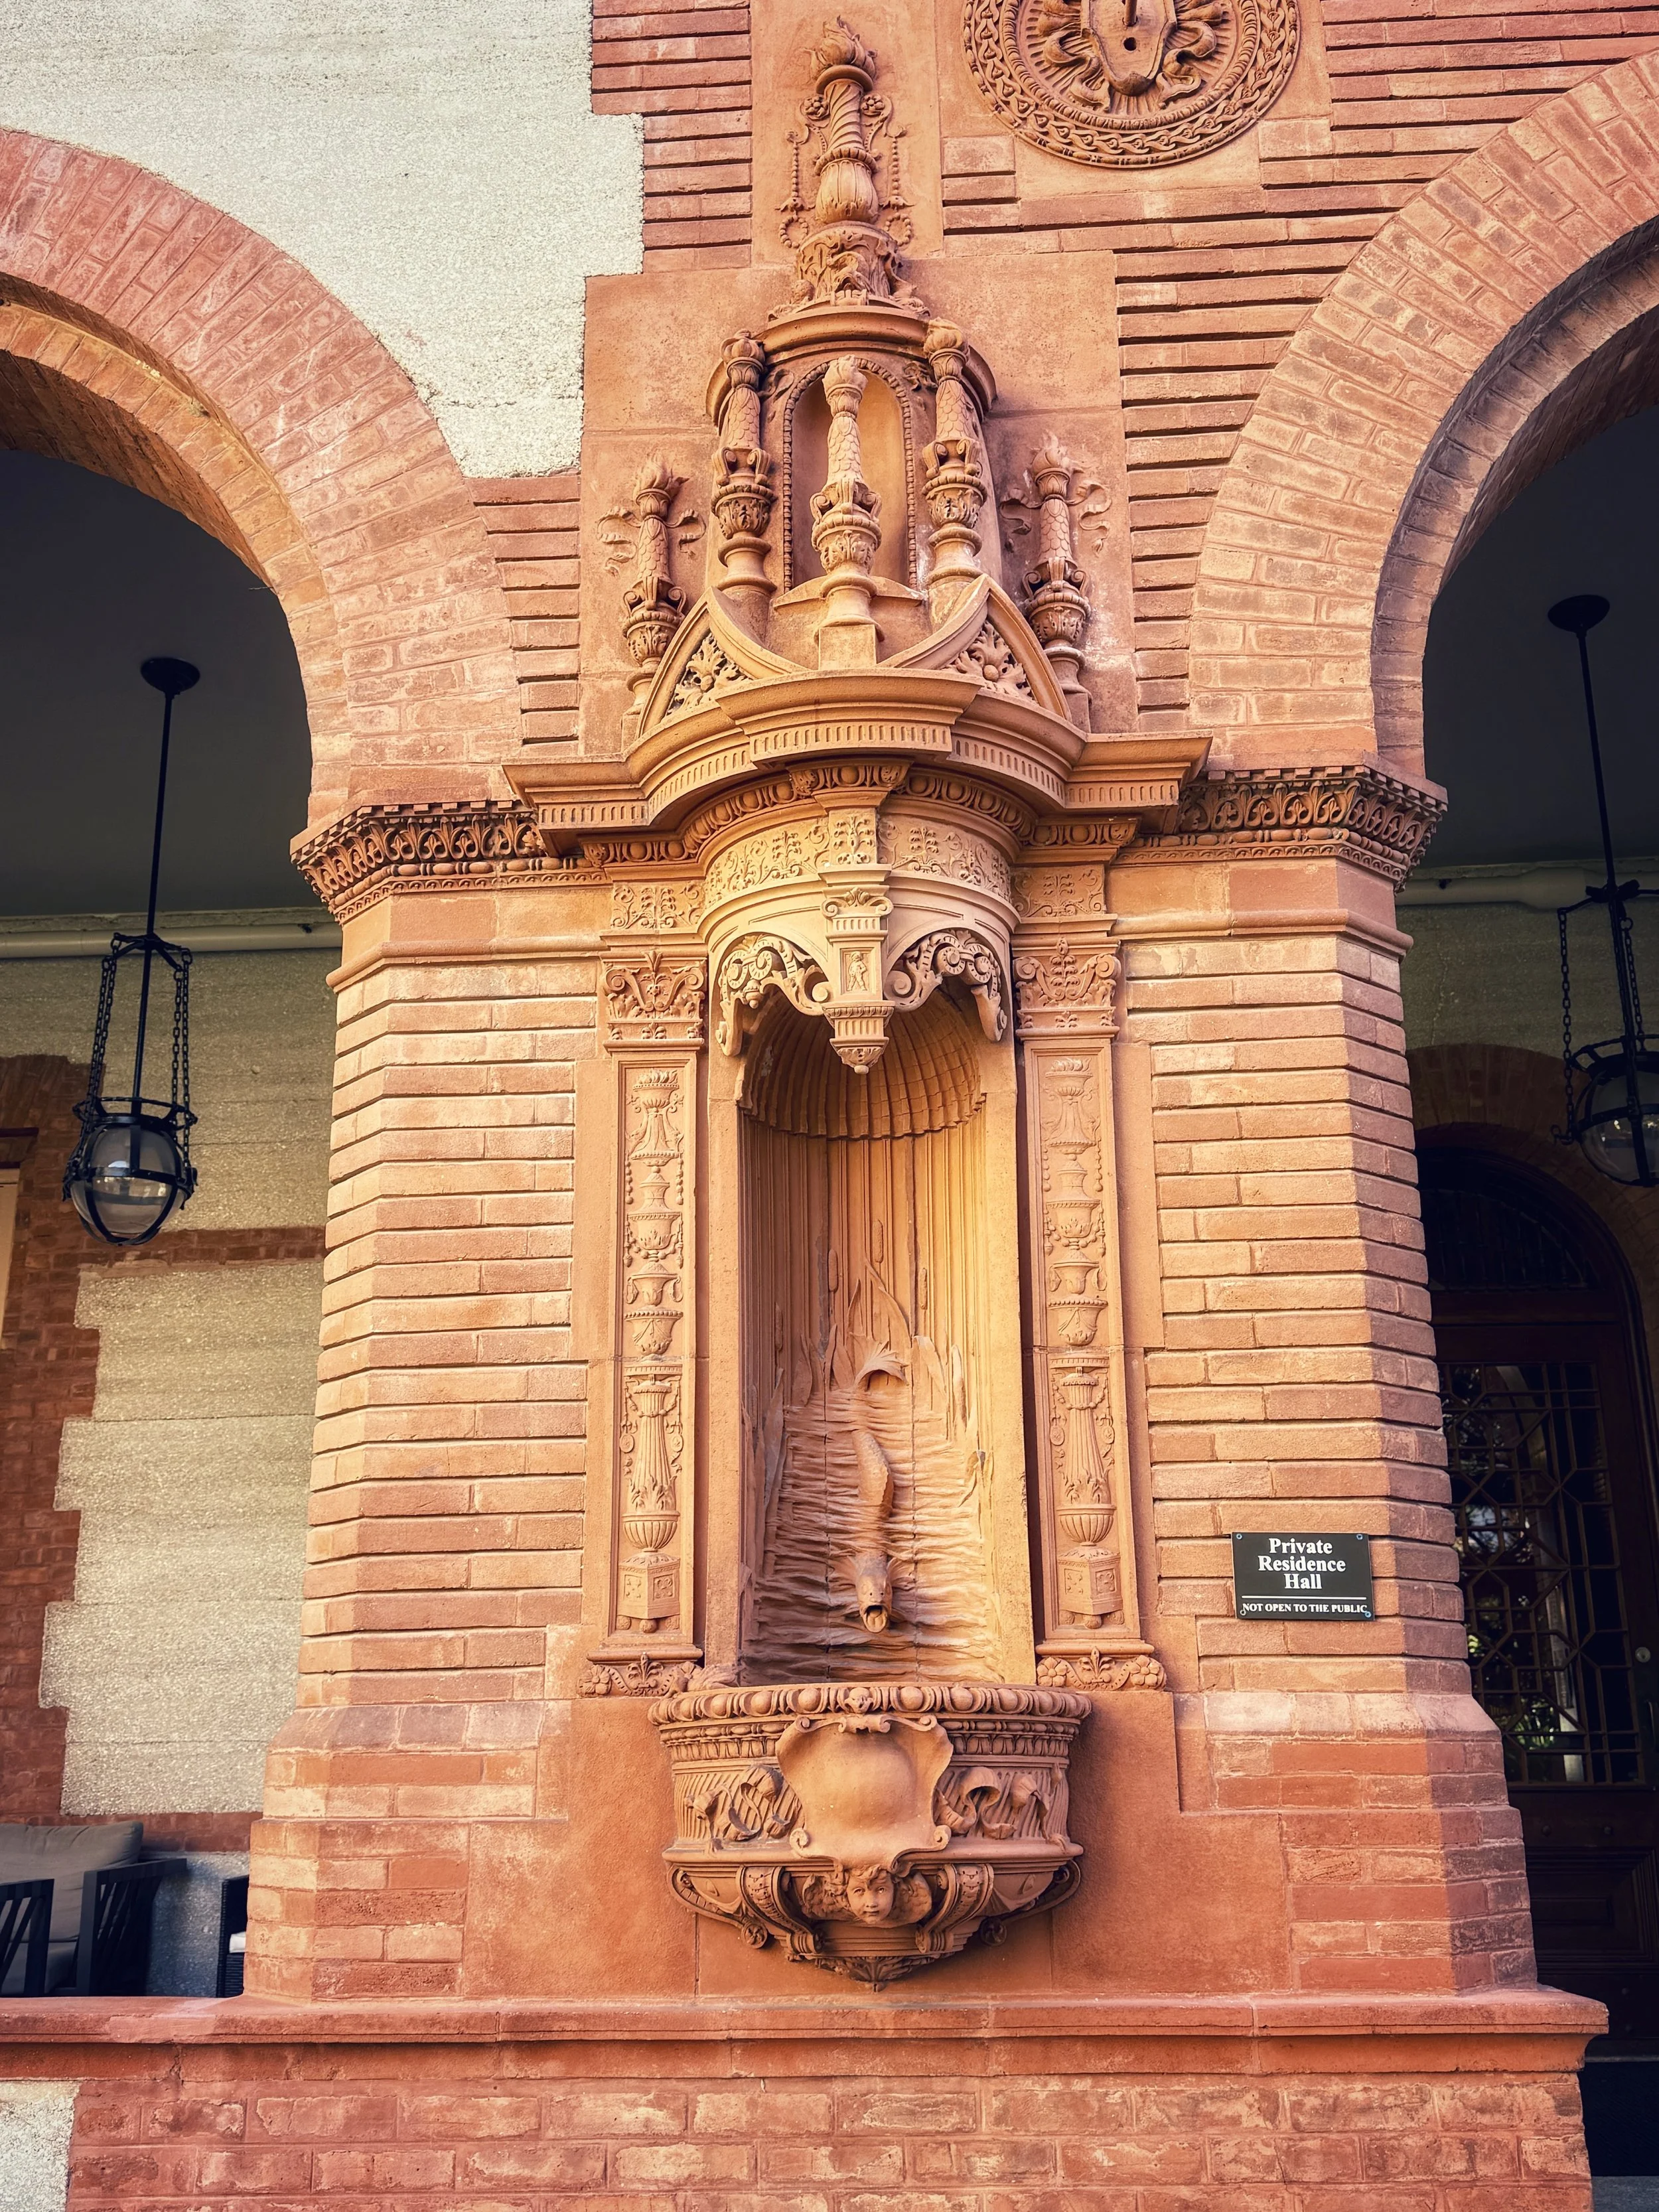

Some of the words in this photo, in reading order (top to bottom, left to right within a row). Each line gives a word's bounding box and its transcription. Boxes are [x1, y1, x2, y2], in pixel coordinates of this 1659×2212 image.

[1269, 1538, 1333, 1554] Private
[1258, 1556, 1346, 1572] Residence
[1284, 1573, 1323, 1589] Hall
[1242, 1603, 1263, 1612] NOT
[1265, 1603, 1291, 1613] OPEN
[1293, 1604, 1307, 1613] TO
[1309, 1604, 1329, 1613] THE
[1331, 1605, 1368, 1613] PUBLIC
